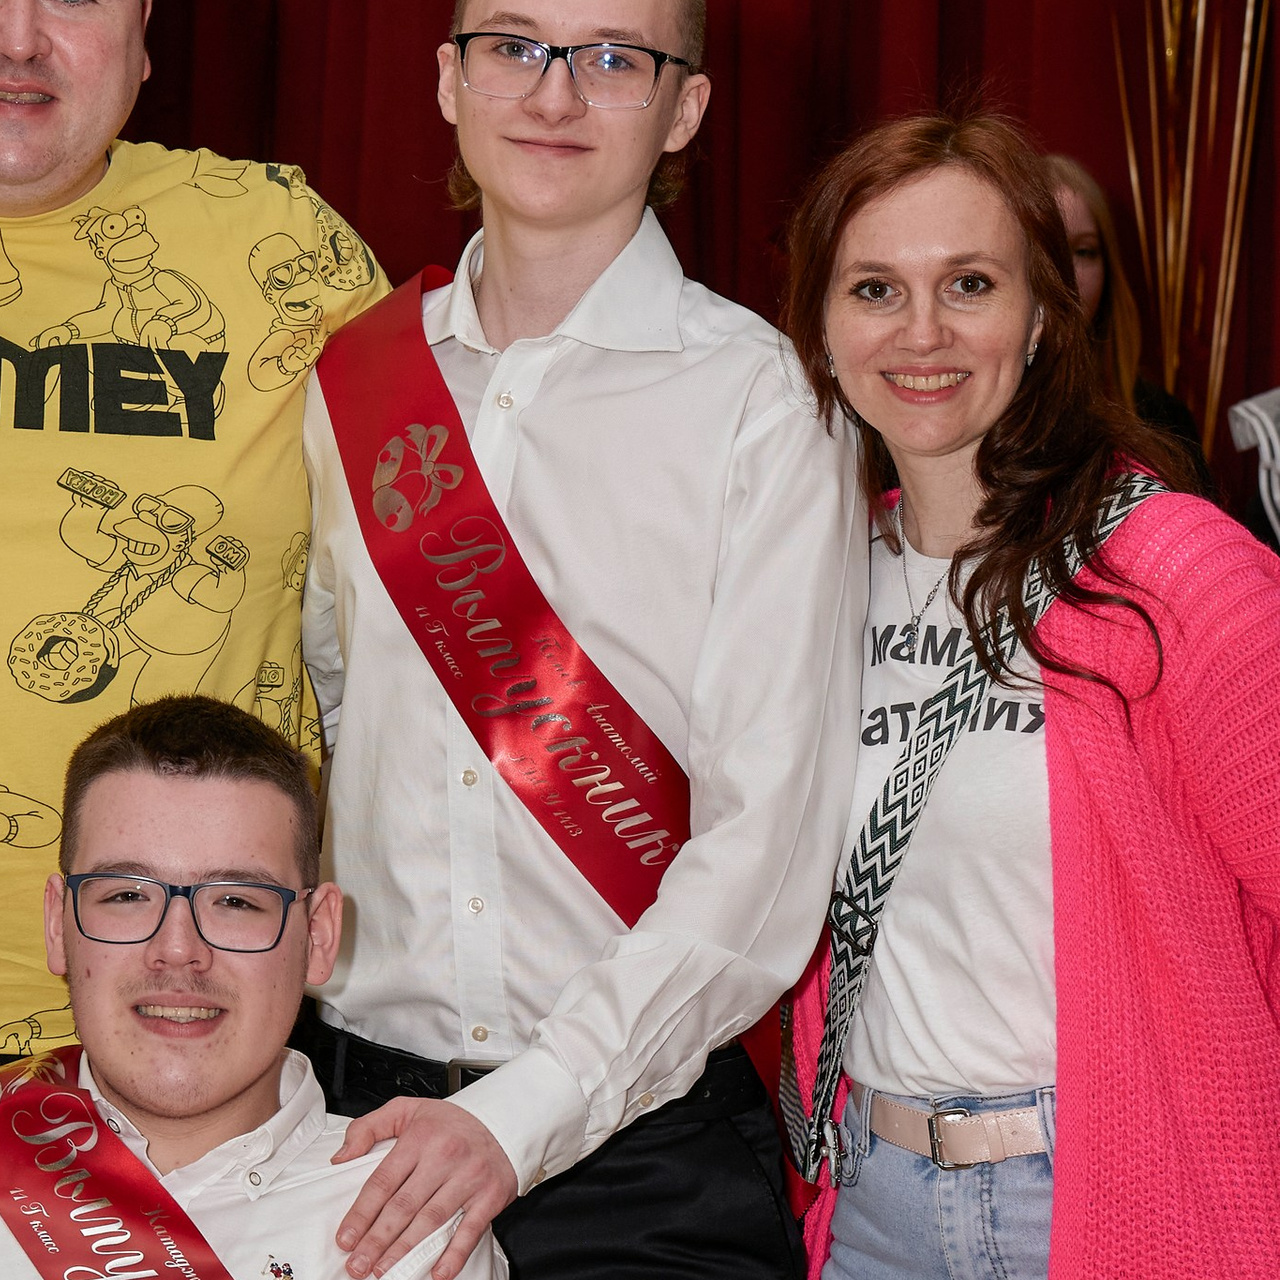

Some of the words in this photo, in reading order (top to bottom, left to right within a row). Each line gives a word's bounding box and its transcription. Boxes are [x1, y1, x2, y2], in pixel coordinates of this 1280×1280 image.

[434, 639, 465, 681] класс
[870, 623, 974, 668] мам
[420, 515, 680, 867] Выпускник
[585, 701, 659, 786] Анатолий
[9, 1186, 29, 1201] 11
[29, 1220, 60, 1255] класс
